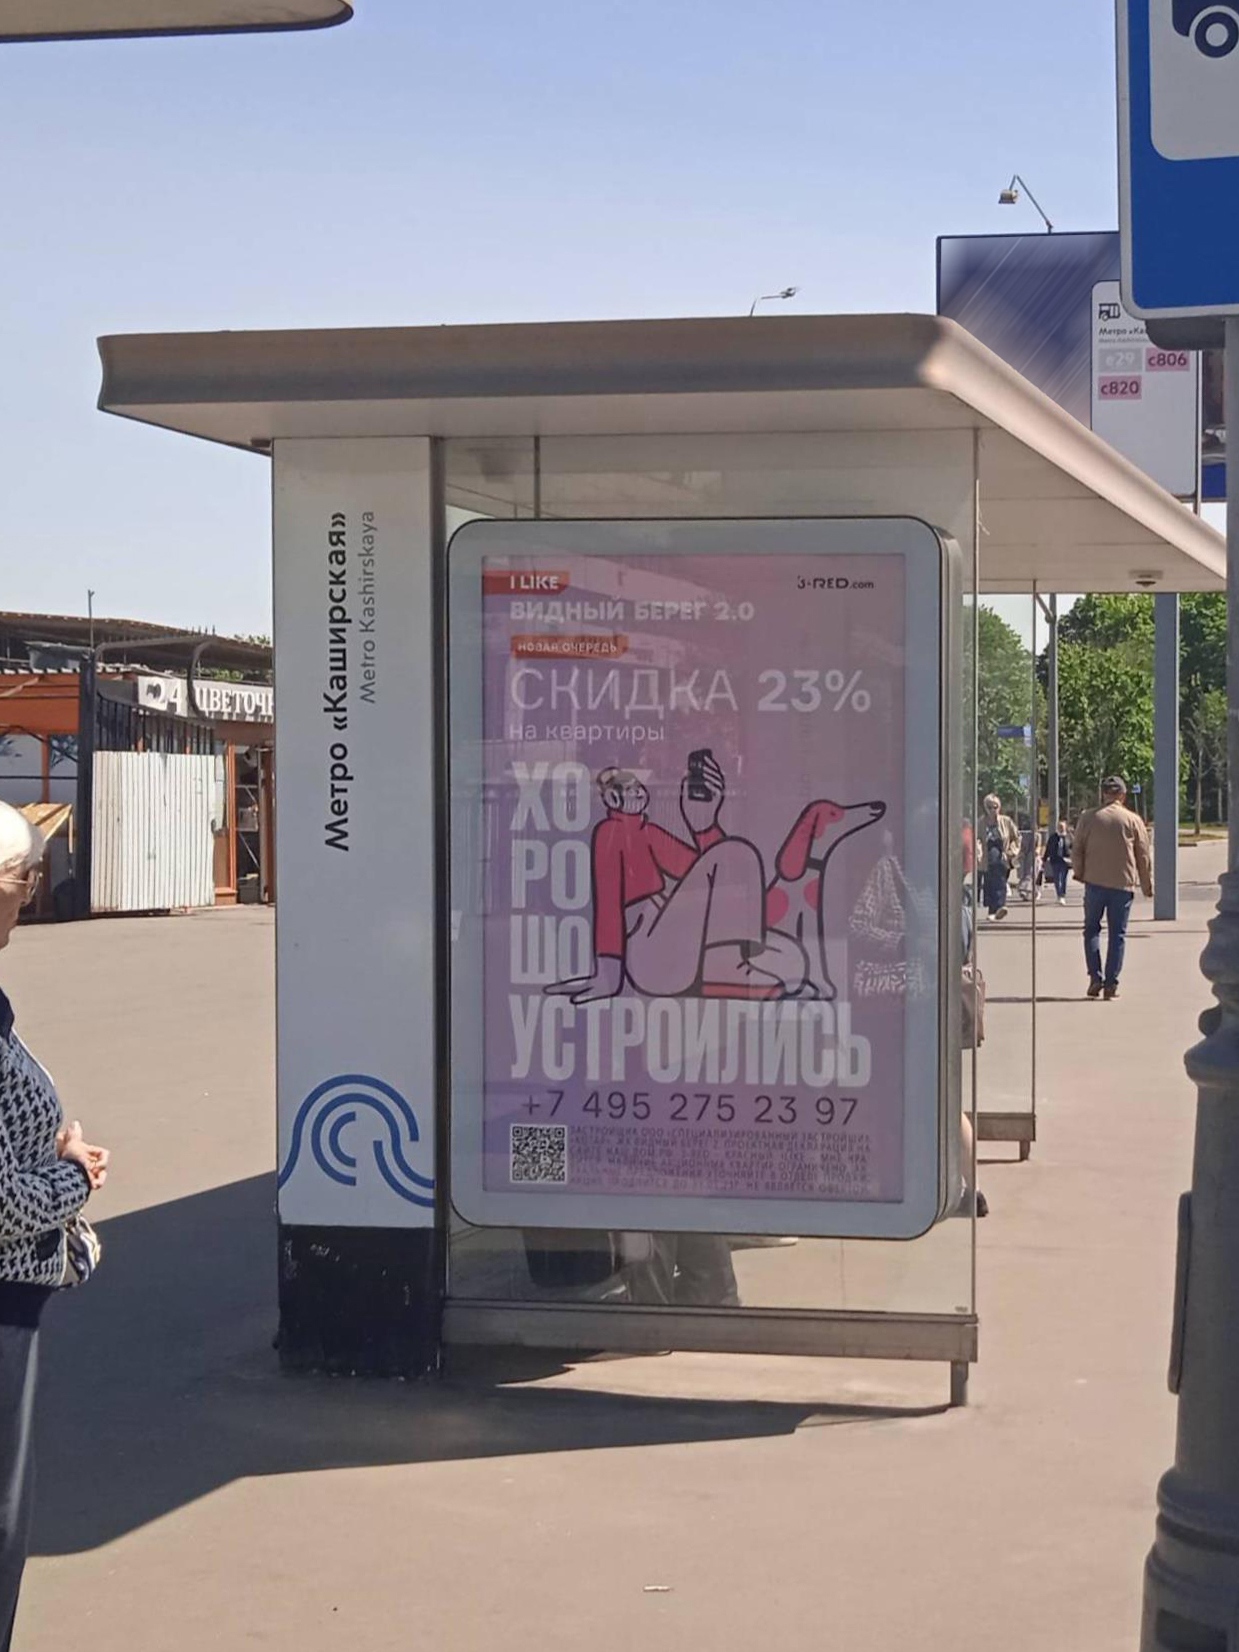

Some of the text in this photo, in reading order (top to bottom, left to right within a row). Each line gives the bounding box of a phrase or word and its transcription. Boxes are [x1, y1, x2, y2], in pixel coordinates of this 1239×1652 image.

[357, 511, 378, 704] Metro Kashirskaya
[510, 596, 755, 624] ВИДНЫЙ БЕРЕГ 2.0
[520, 575, 560, 590] LIKE
[323, 512, 354, 852] Метро «Каширская»
[510, 667, 873, 721] СКИДКА 23%
[509, 725, 665, 745] на квартиры
[510, 761, 591, 832] ХО
[511, 838, 591, 910] РО
[510, 914, 591, 985] ШО
[510, 993, 873, 1088] УСТРОИЛИСЬ
[521, 1090, 859, 1127] +7 495 275 23 97
